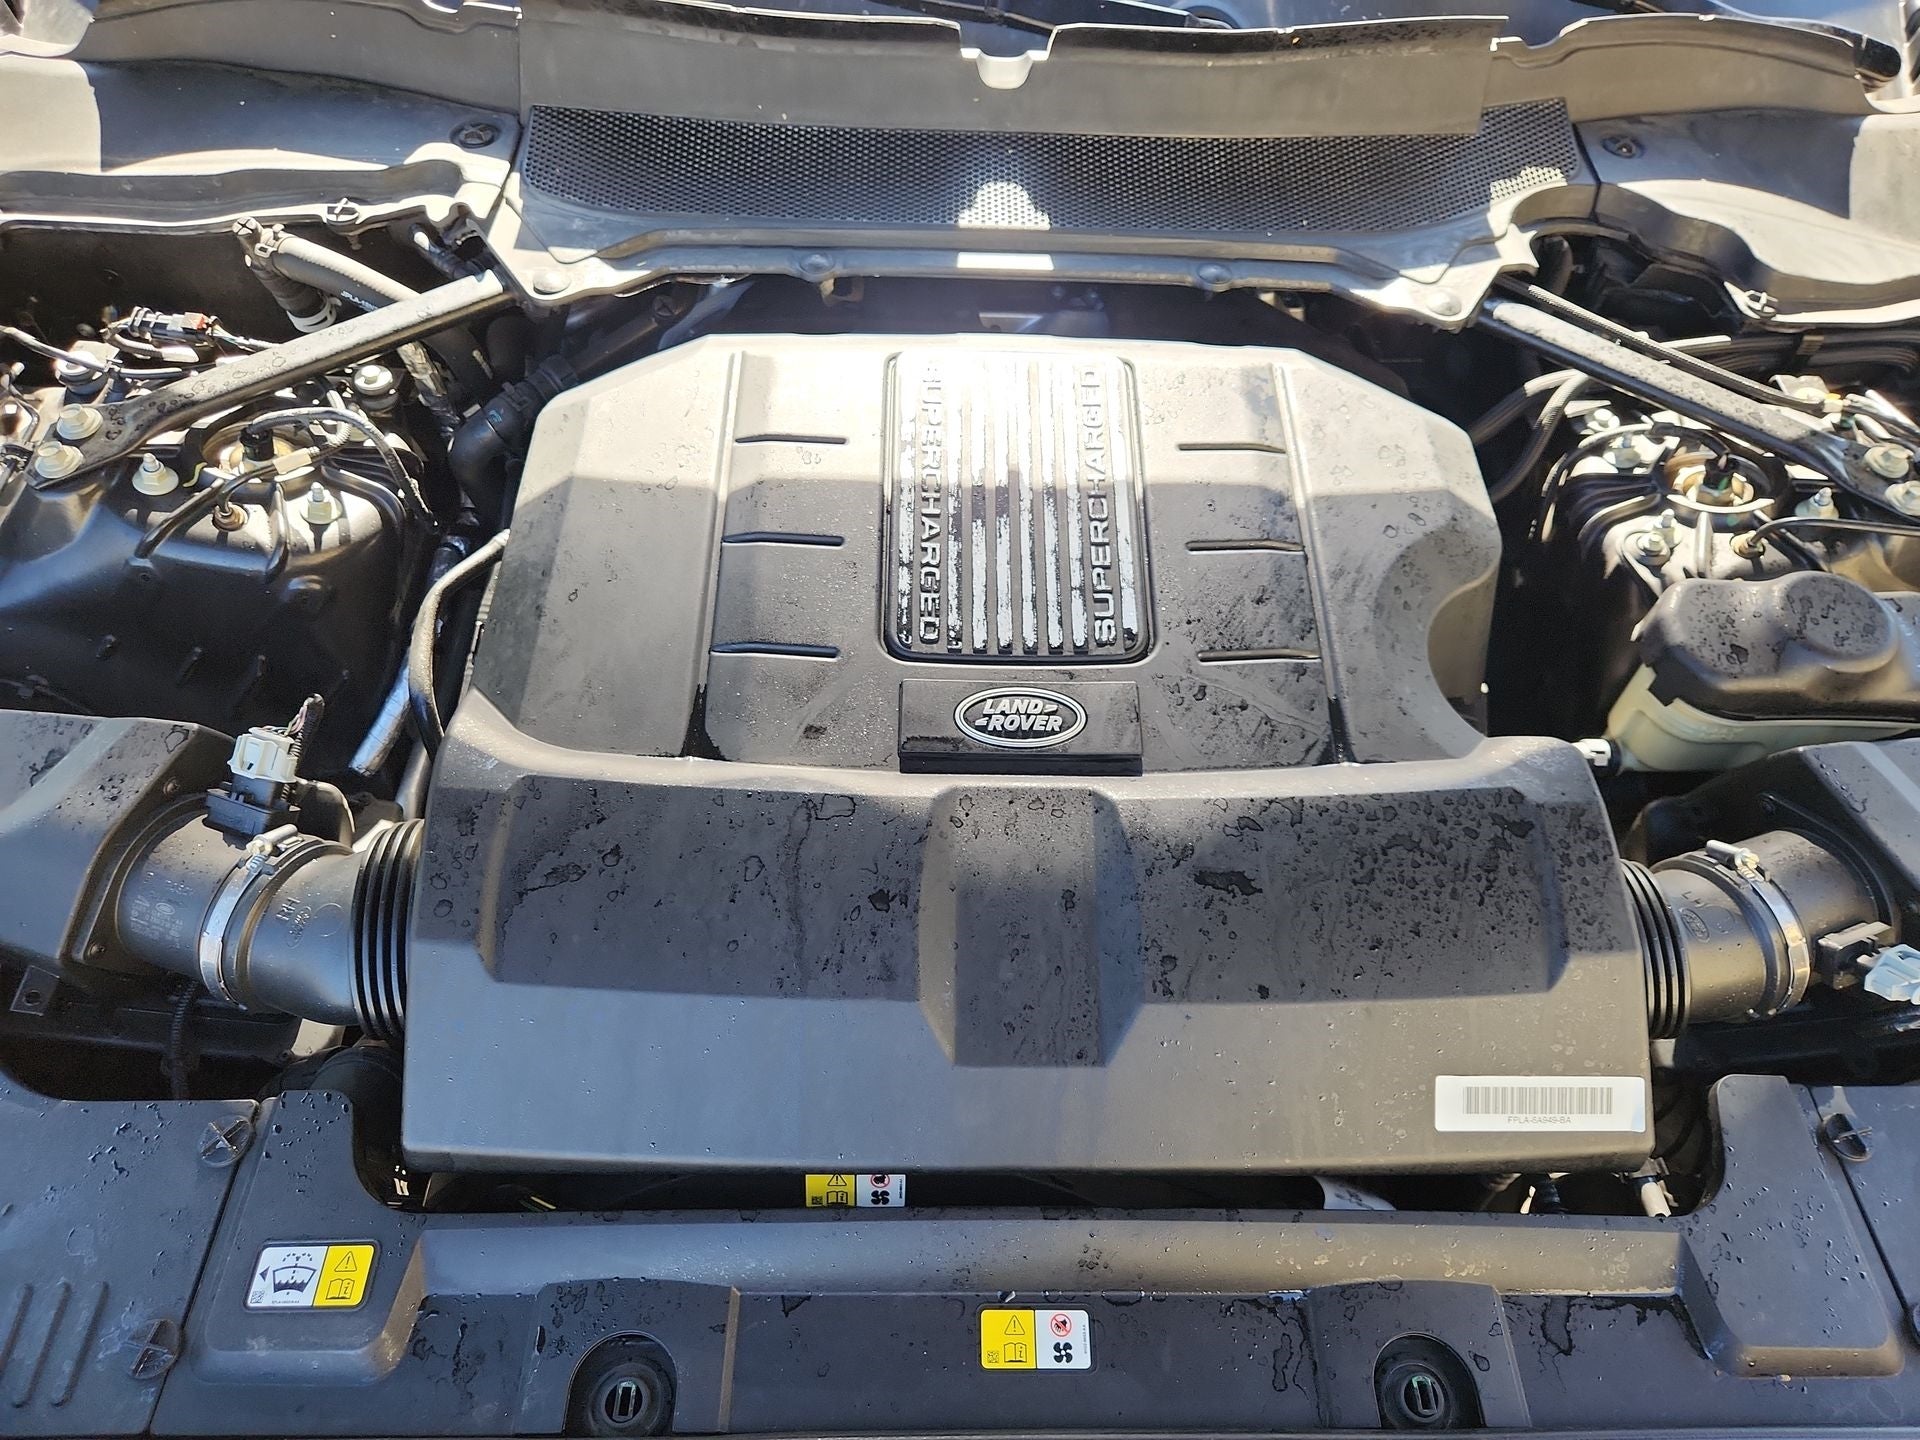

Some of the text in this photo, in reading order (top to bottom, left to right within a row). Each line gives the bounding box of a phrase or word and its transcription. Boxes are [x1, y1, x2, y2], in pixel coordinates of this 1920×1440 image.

[920, 361, 942, 643] SUPERCHARGED
[1080, 368, 1116, 647] SUPERCHARGED
[982, 698, 1044, 715] LAND
[987, 714, 1063, 732] ROVER
